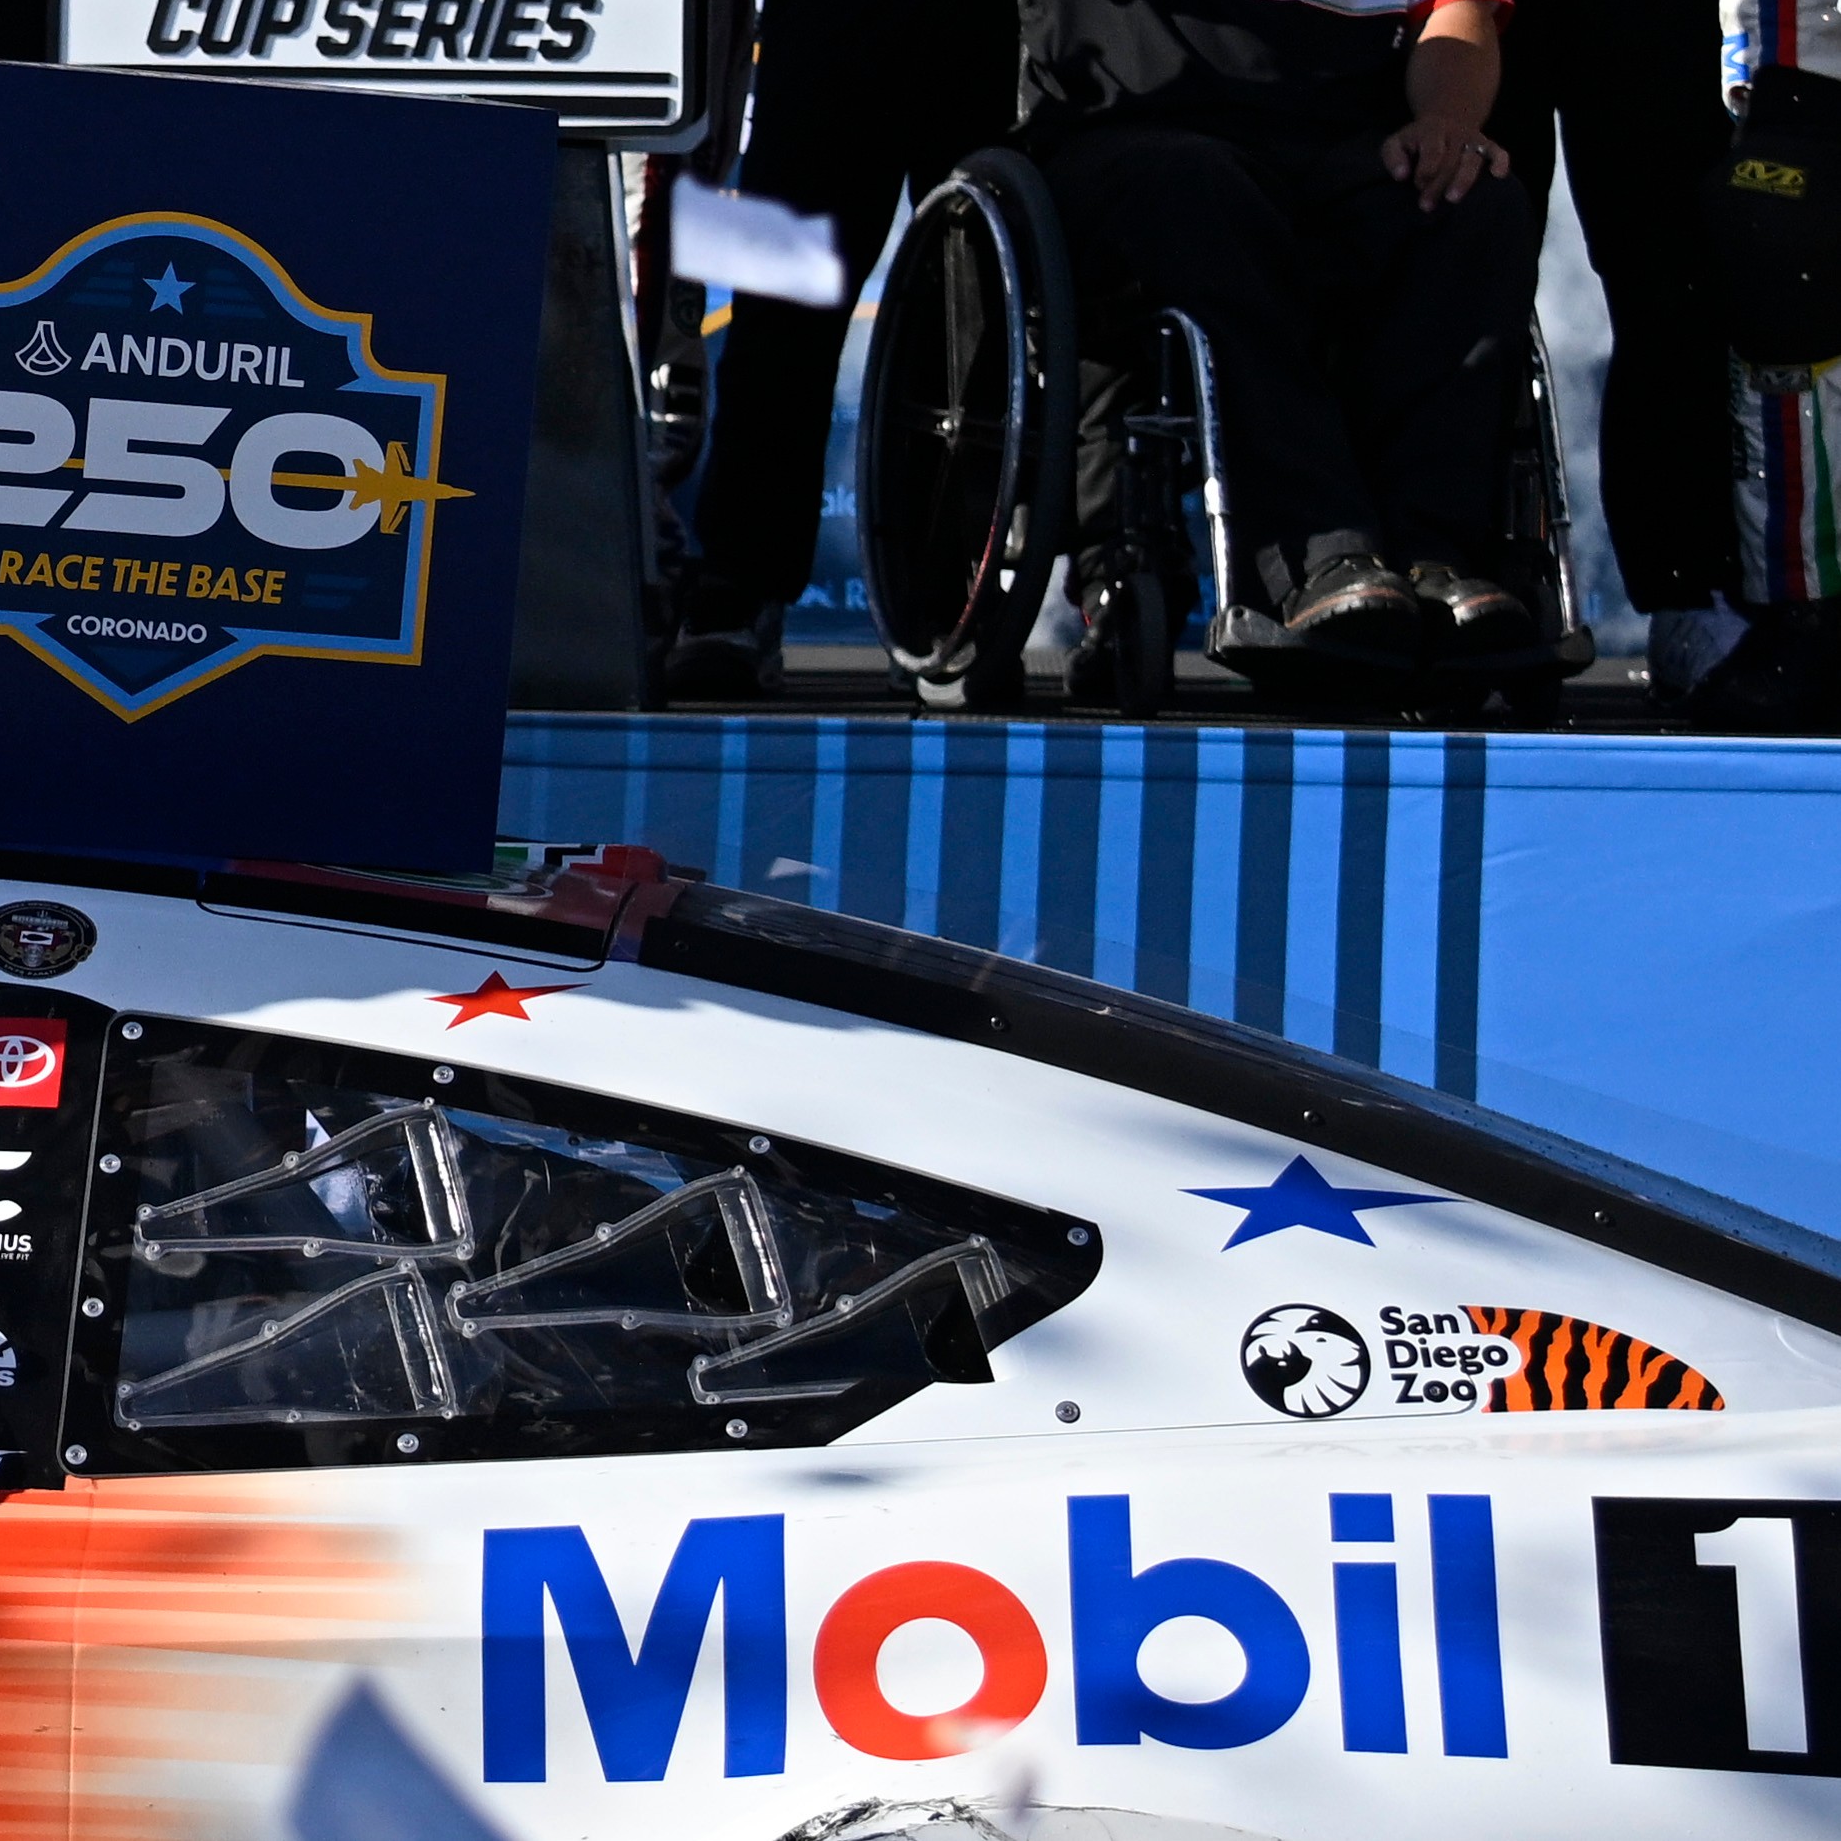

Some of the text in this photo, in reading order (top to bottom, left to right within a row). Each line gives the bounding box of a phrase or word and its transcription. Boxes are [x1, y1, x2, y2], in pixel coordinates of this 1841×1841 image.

[81, 332, 305, 389] ANDURIL
[112, 557, 180, 597] THE
[184, 563, 286, 605] BASE
[66, 613, 208, 645] CORONADO
[1378, 1305, 1461, 1337] San
[1384, 1336, 1509, 1376] Diego
[1390, 1372, 1477, 1405] Zoo
[481, 1491, 1509, 1785] Mobil
